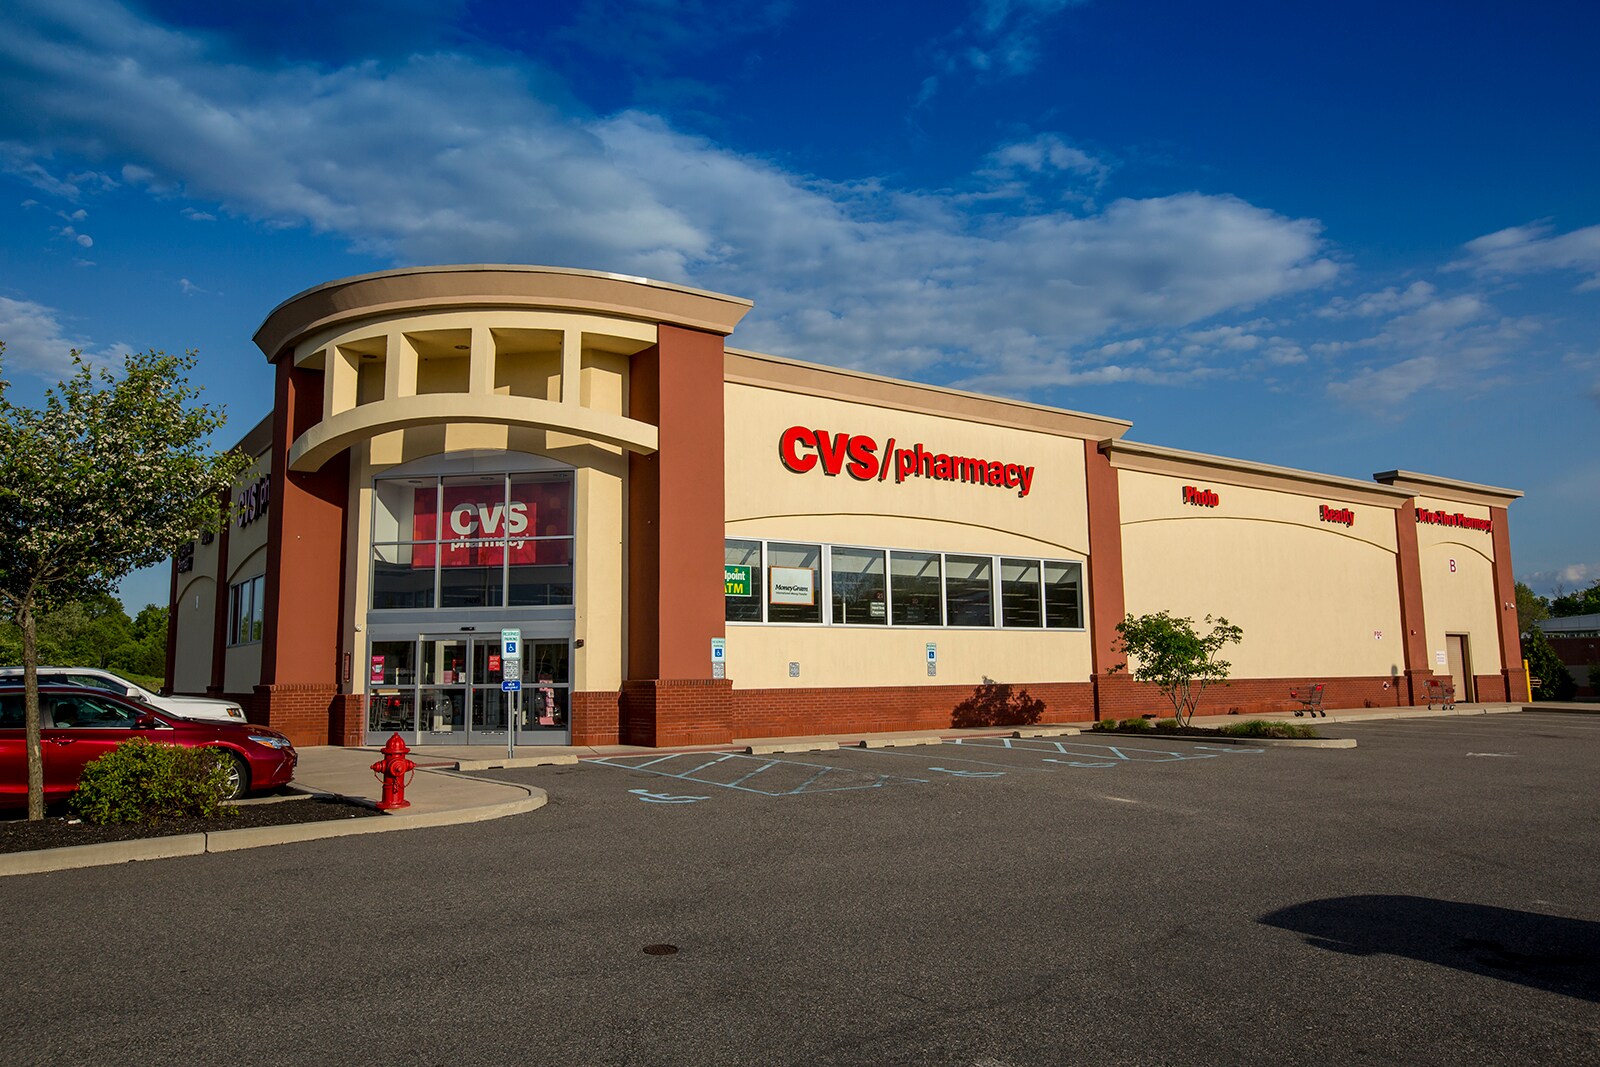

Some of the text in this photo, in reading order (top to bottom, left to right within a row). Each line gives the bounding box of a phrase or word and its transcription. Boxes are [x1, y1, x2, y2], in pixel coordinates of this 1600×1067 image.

[779, 425, 1035, 497] CVS/pharmacy
[1183, 486, 1219, 507] Photo
[450, 502, 528, 535] CVS
[1320, 505, 1354, 527] Beauty
[1456, 513, 1493, 534] Pharmacy
[1449, 559, 1457, 573] B
[775, 584, 809, 592] MoneyGram
